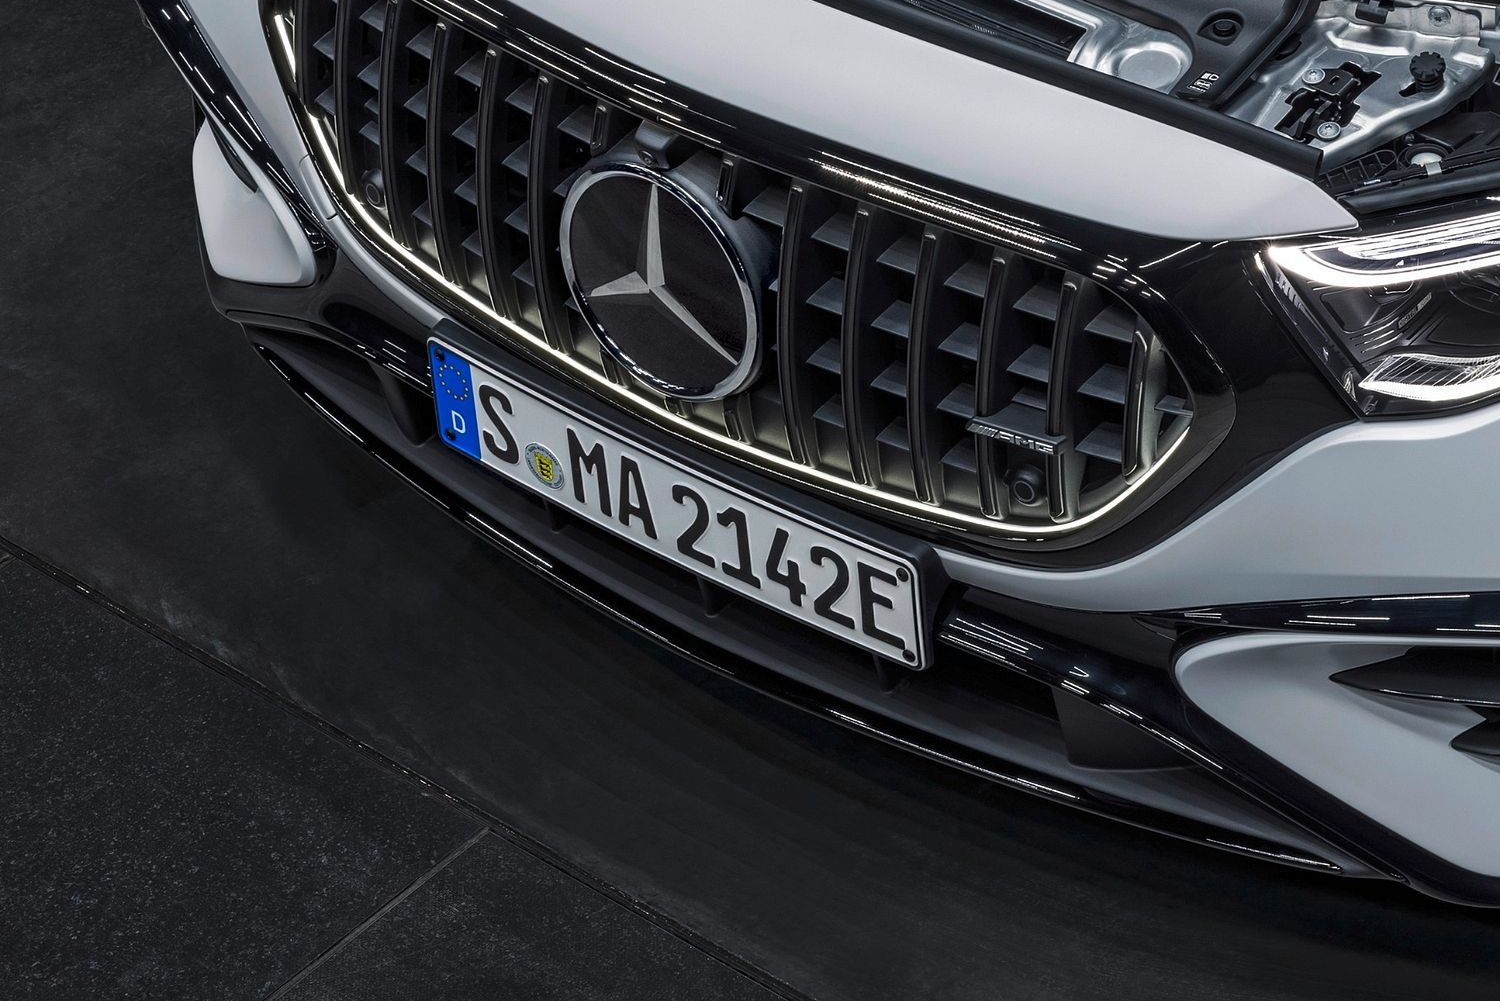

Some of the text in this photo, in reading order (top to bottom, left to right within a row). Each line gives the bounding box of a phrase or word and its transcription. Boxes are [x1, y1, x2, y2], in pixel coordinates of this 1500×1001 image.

[451, 409, 467, 434] D
[996, 430, 1055, 455] AMG
[478, 383, 907, 651] S MA 2142E
